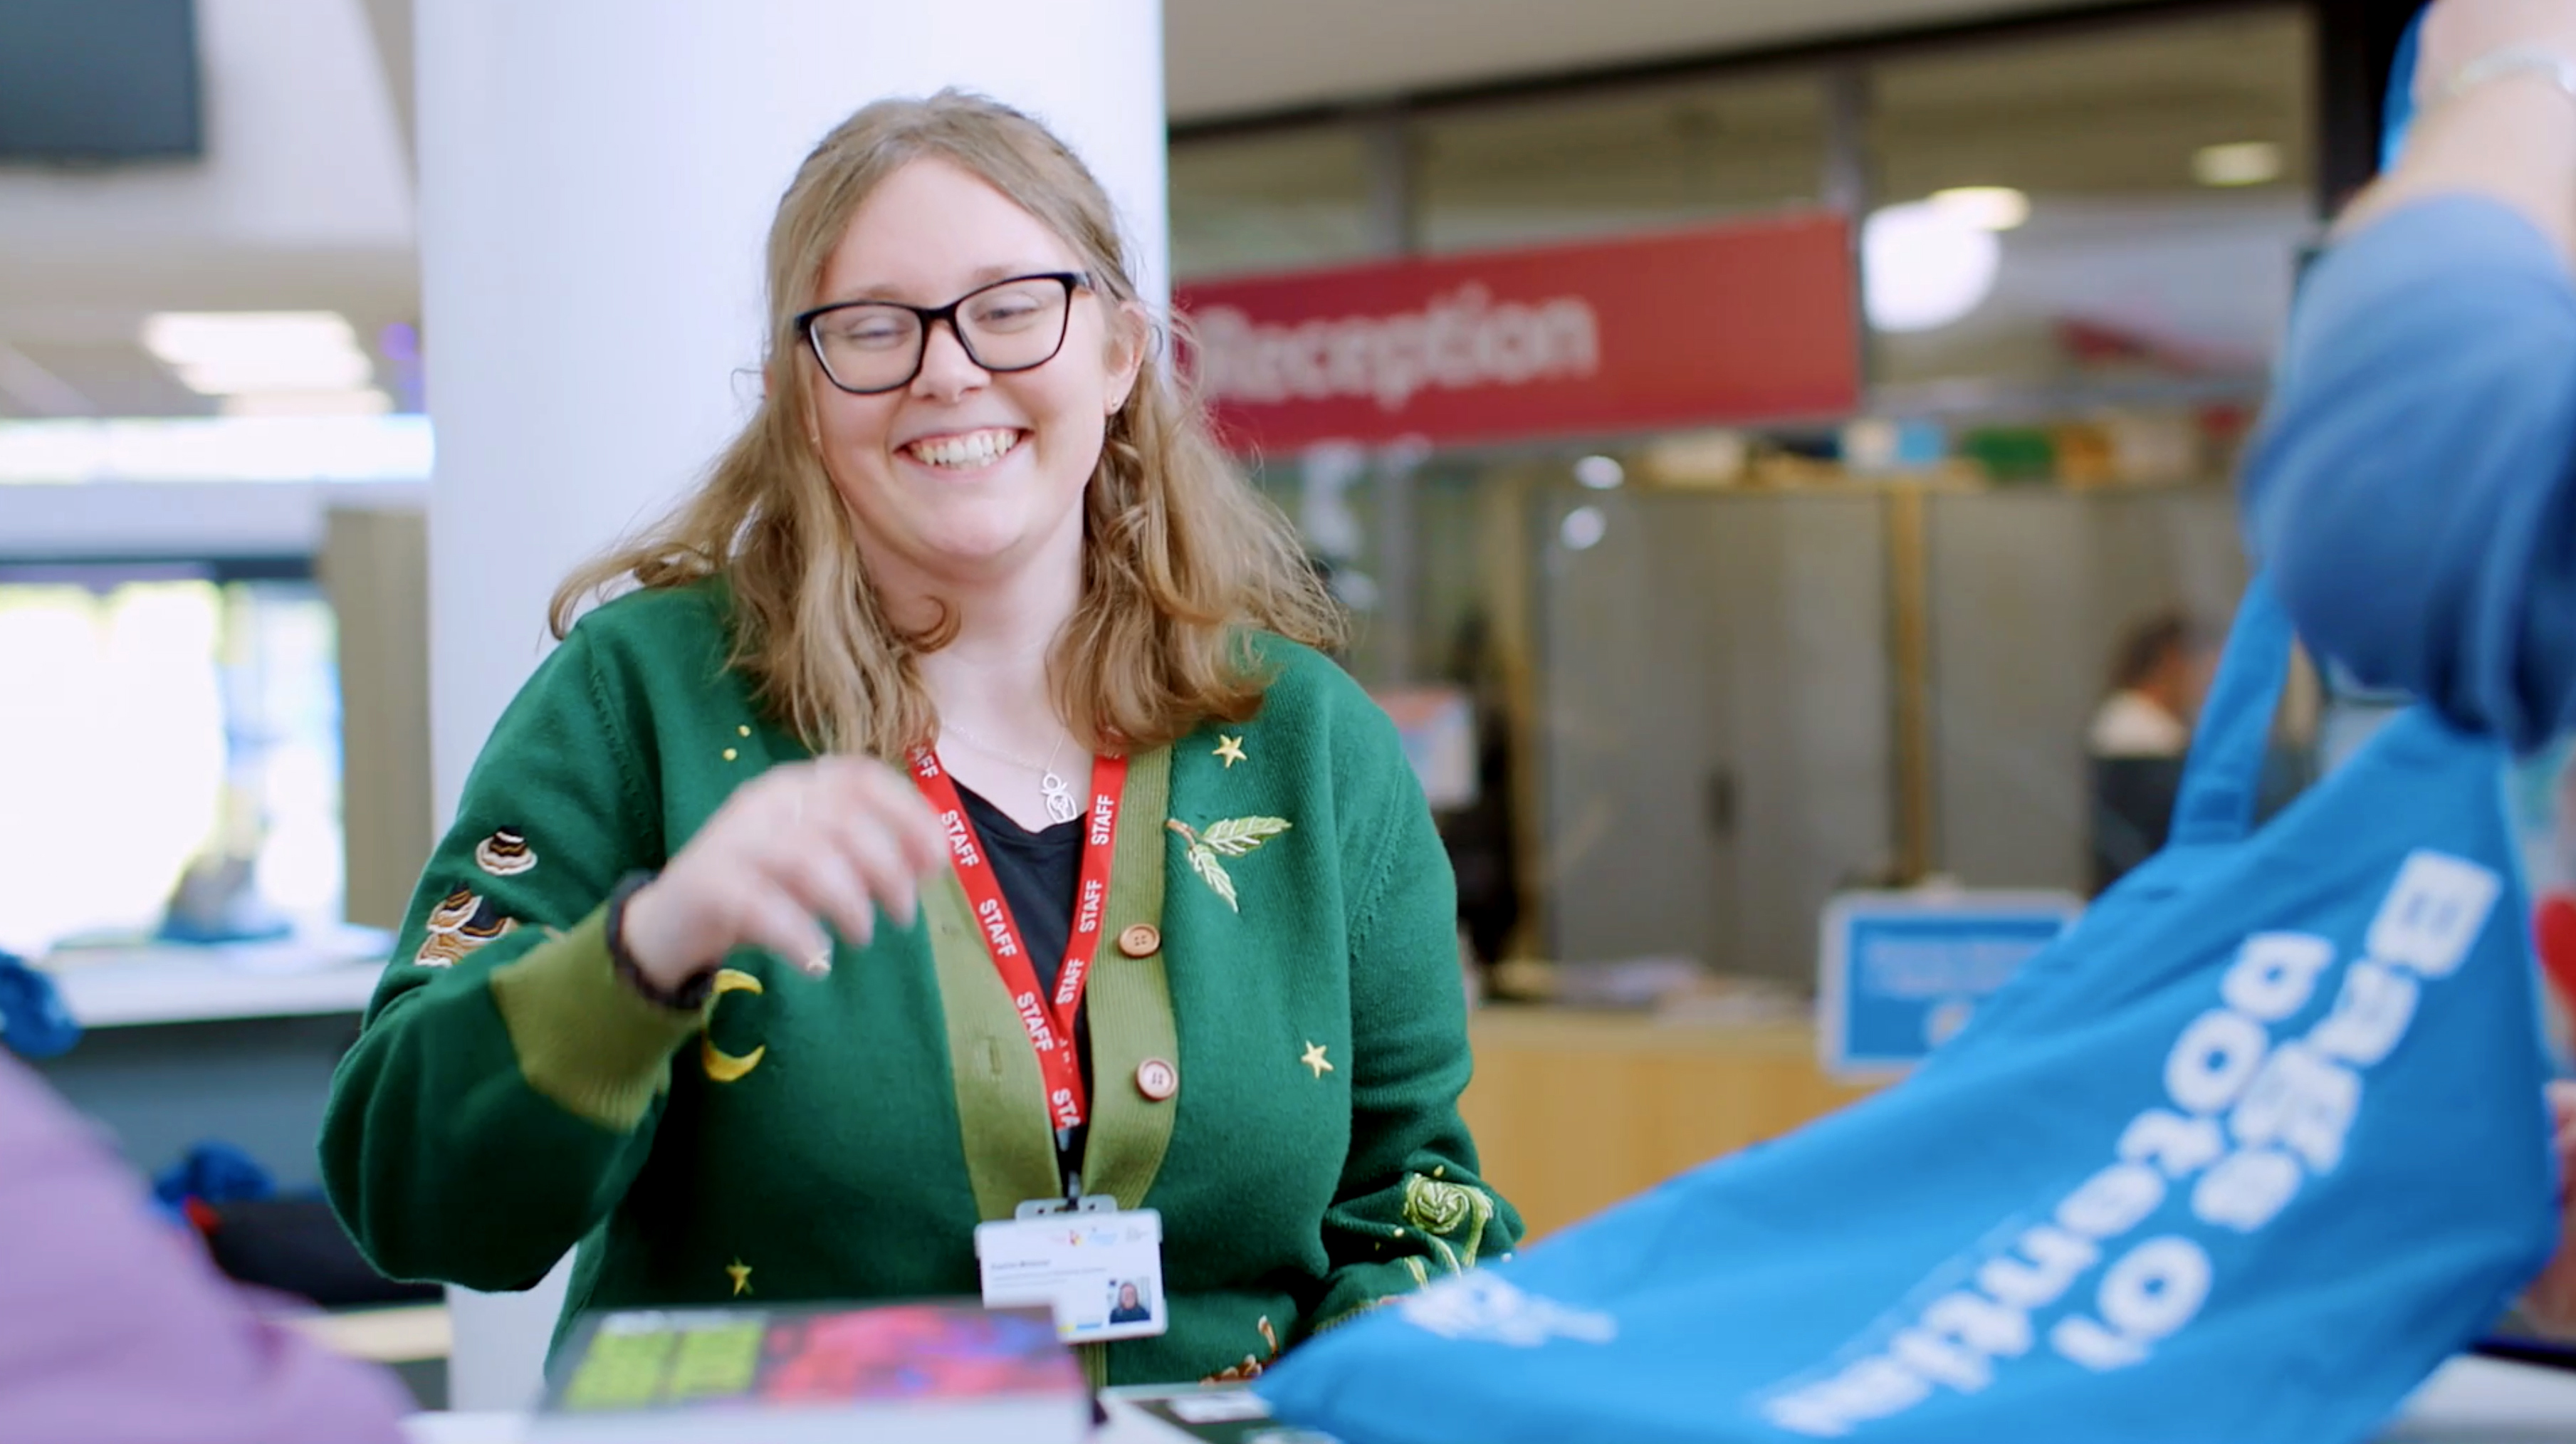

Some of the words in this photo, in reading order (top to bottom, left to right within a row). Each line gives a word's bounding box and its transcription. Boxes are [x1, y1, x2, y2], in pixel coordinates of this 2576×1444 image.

[1196, 282, 1599, 412] Reception
[914, 748, 939, 778] AFF
[941, 809, 980, 867] STAFF
[1091, 794, 1114, 846] STAFF
[979, 898, 1017, 958] STAFF
[1079, 879, 1103, 933] STAFF
[1055, 958, 1084, 1005] STAFF
[1017, 991, 1054, 1052] STAFF
[2190, 847, 2502, 1233] Bags
[1052, 1088, 1082, 1128] STA
